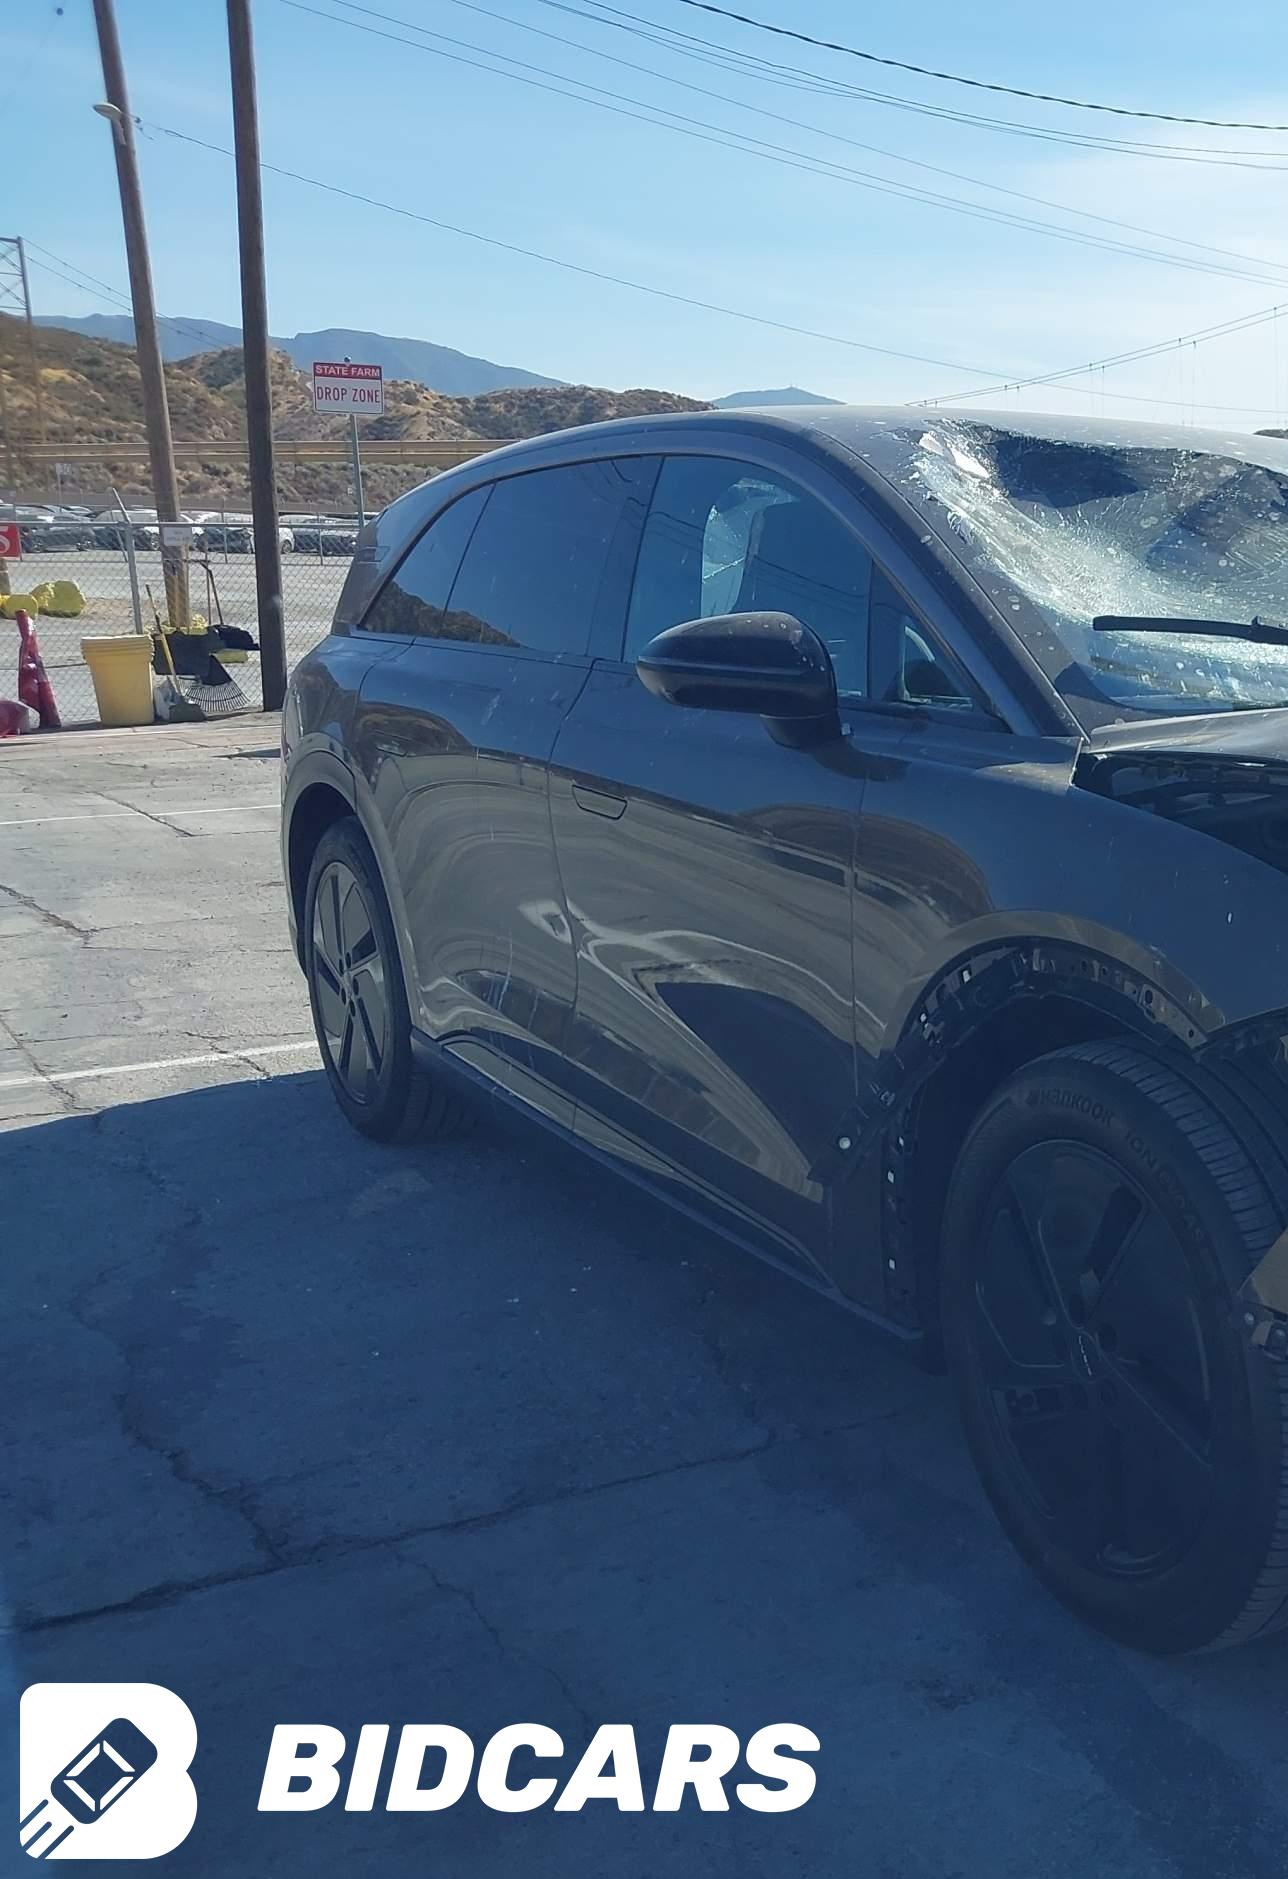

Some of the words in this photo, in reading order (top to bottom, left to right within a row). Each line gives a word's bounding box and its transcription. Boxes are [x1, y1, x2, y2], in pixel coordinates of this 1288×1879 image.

[315, 365, 348, 376] STATE
[351, 367, 380, 377] FARM
[316, 386, 348, 401] DROP
[352, 388, 380, 403] ZONE
